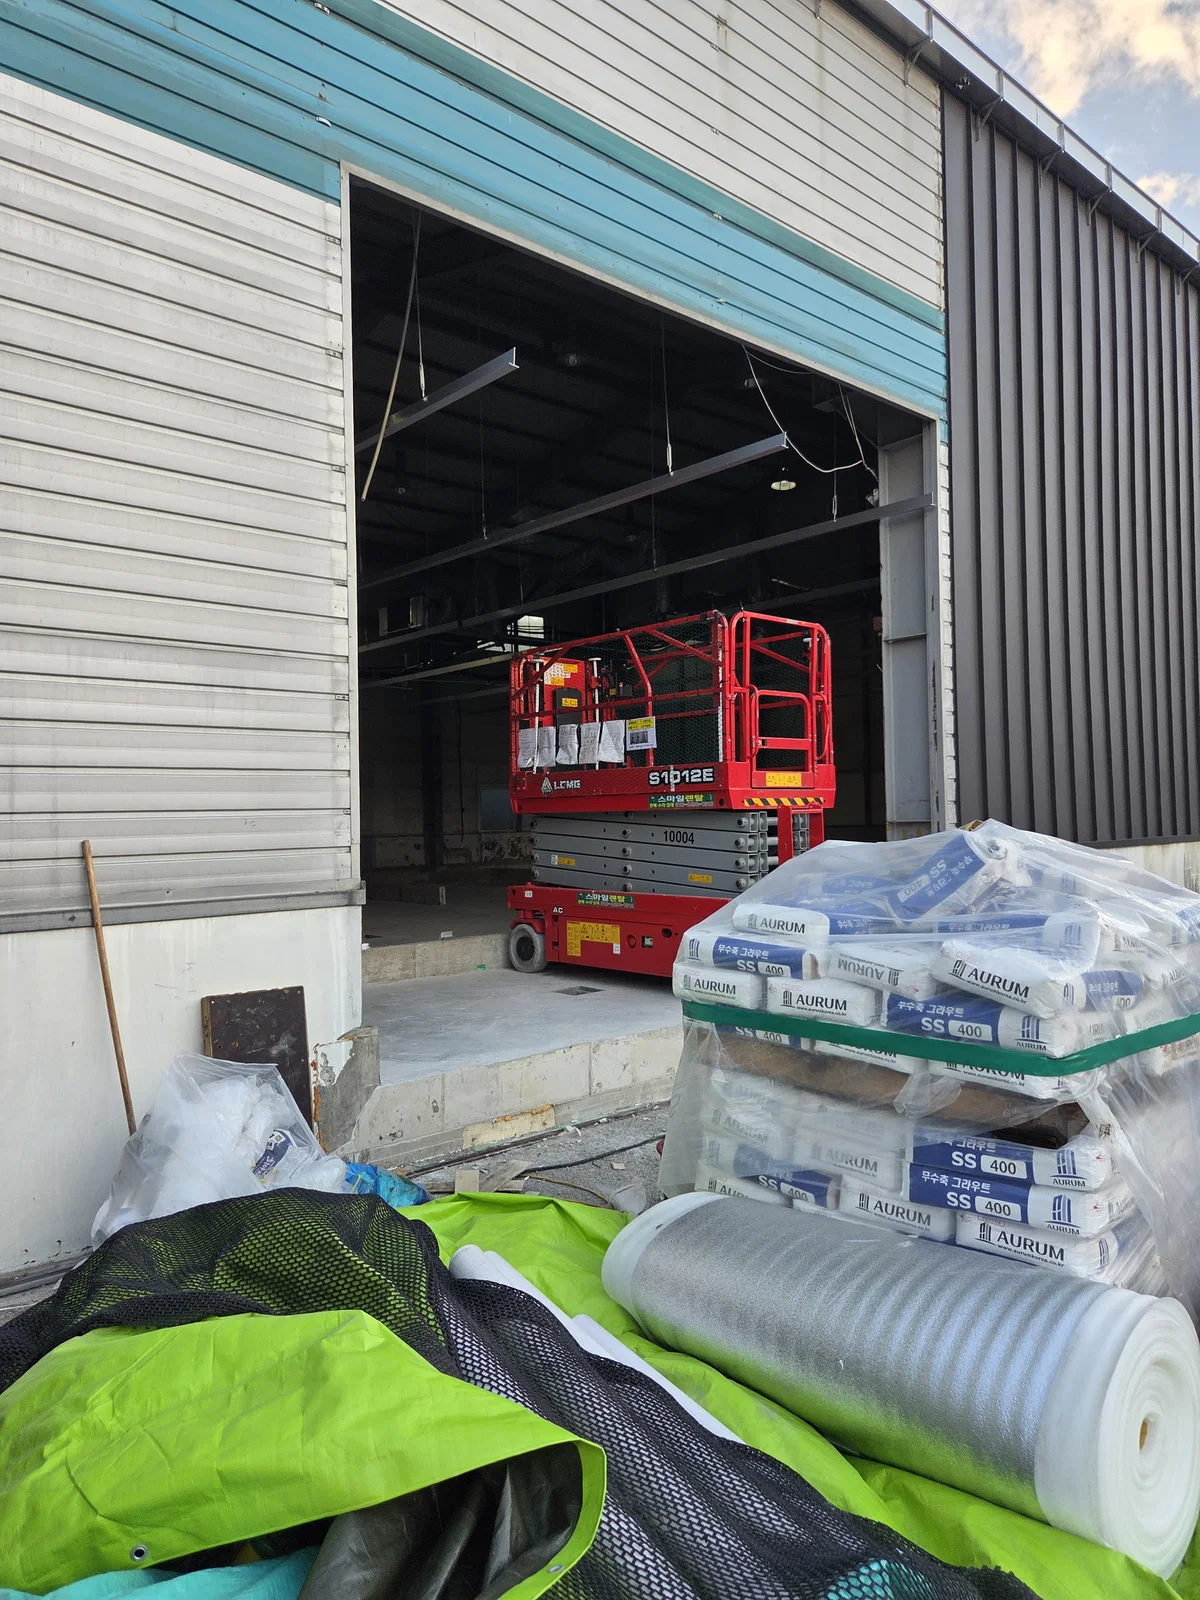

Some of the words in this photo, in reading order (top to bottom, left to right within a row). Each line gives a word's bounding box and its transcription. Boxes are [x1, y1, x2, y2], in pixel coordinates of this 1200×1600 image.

[663, 830, 695, 844] 10004
[929, 859, 947, 878] SS
[904, 879, 922, 896] 400
[553, 906, 564, 914] AC
[760, 917, 805, 934] AURUM
[717, 944, 739, 956] 무수축
[740, 947, 769, 960] 그라우트
[736, 959, 756, 972] SS
[764, 964, 784, 976] 400
[838, 958, 884, 981] AURUM
[694, 978, 737, 995] AURUM
[967, 967, 1030, 999] AURUM
[967, 980, 1027, 1004] www.aurumkorea.co.kr
[796, 994, 847, 1011] AURUM
[796, 1006, 847, 1016] www.aurumkorea.co.kr
[926, 1003, 965, 1018] 그라우트
[921, 1017, 945, 1033] SS
[957, 1024, 982, 1038] 400
[763, 1031, 782, 1043] 400
[1016, 1041, 1047, 1052] AURUM
[963, 1070, 1025, 1087] www.aurumkorea.co.kr
[825, 1148, 878, 1173] AURUM
[951, 1151, 977, 1169] SS
[990, 1159, 1017, 1176] 400
[758, 1175, 778, 1191] SS
[788, 1188, 808, 1201] 400
[921, 1170, 949, 1186] 무수축
[951, 1177, 991, 1194] 그라우트
[1052, 1178, 1086, 1188] AURUM
[946, 1191, 971, 1209] SS
[984, 1200, 1011, 1217] 400
[873, 1200, 931, 1227] AURUM
[1046, 1223, 1080, 1236] AURUM
[997, 1230, 1065, 1262] AURUM
[997, 1244, 1065, 1268] www.aurumkorea.co.kr
